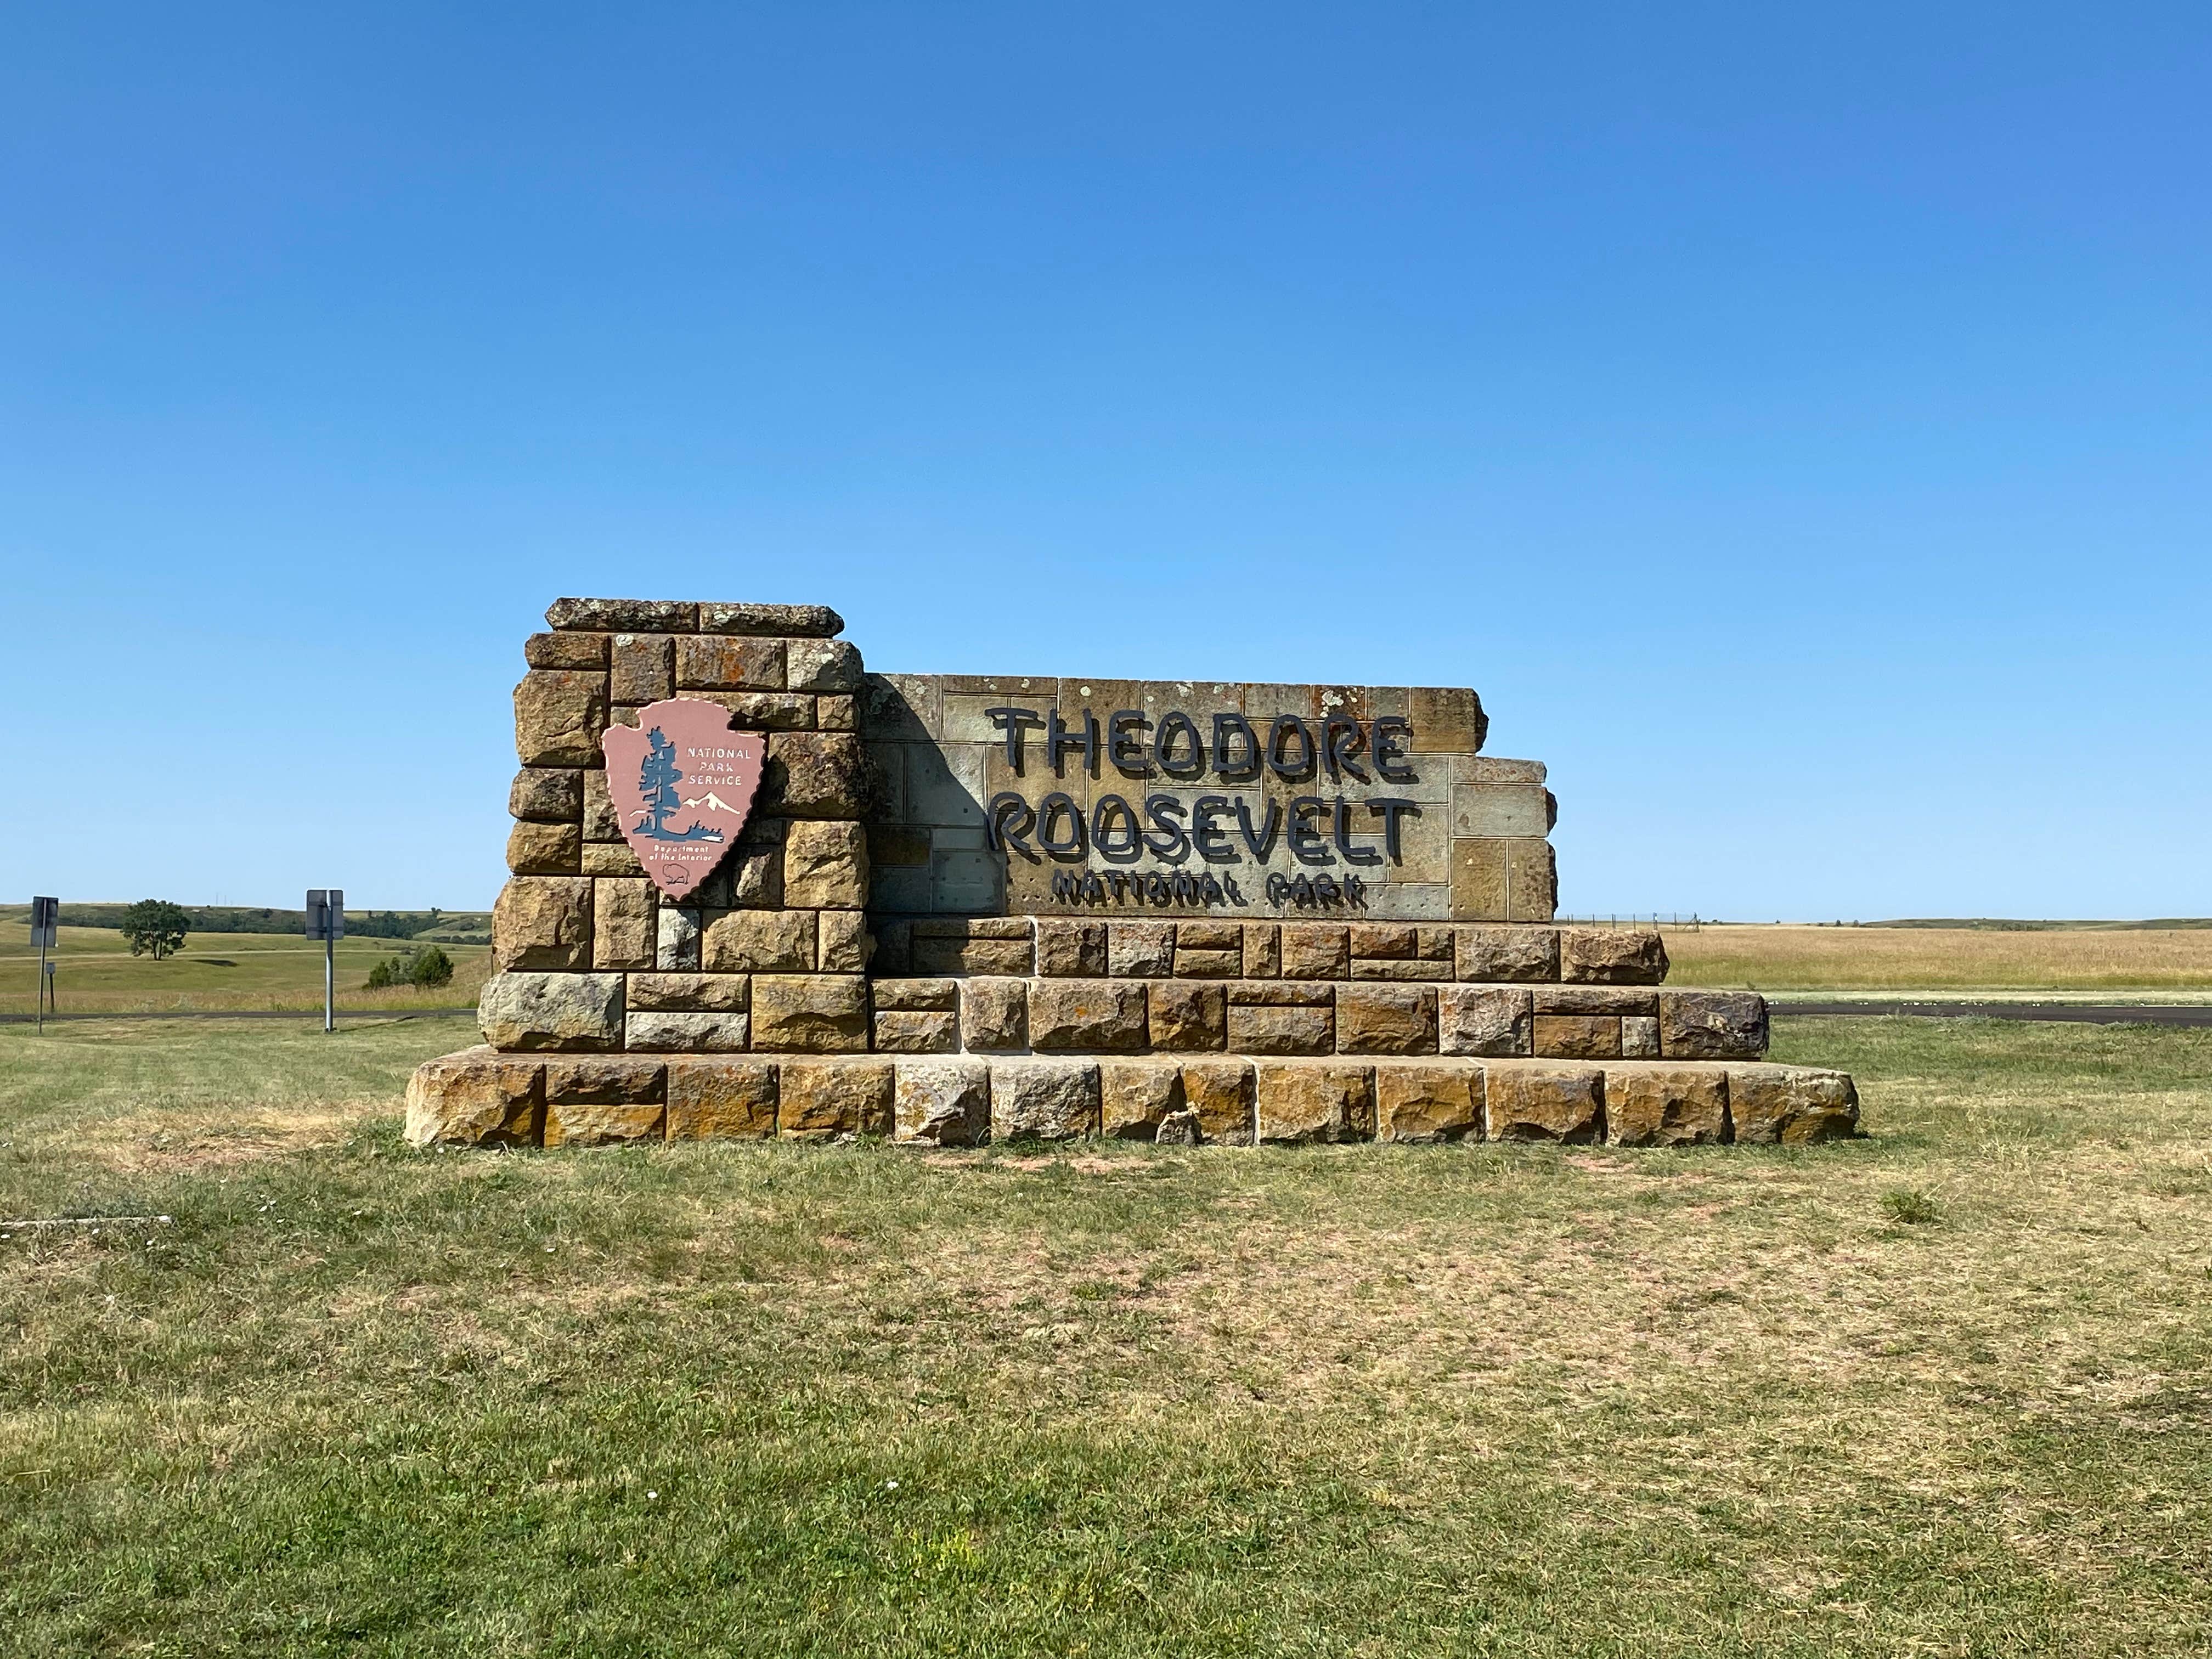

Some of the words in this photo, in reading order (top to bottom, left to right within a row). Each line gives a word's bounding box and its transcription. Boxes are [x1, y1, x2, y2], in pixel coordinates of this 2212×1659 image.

[985, 708, 1413, 774] THEODORE
[687, 747, 751, 759] NATIONAL
[699, 761, 733, 772] PARK
[689, 775, 742, 786] SERVICE
[986, 792, 1415, 857] ROOSEVELT
[654, 844, 709, 853] Department
[1052, 869, 1241, 899] NATIONAL
[1266, 871, 1364, 901] PARK
